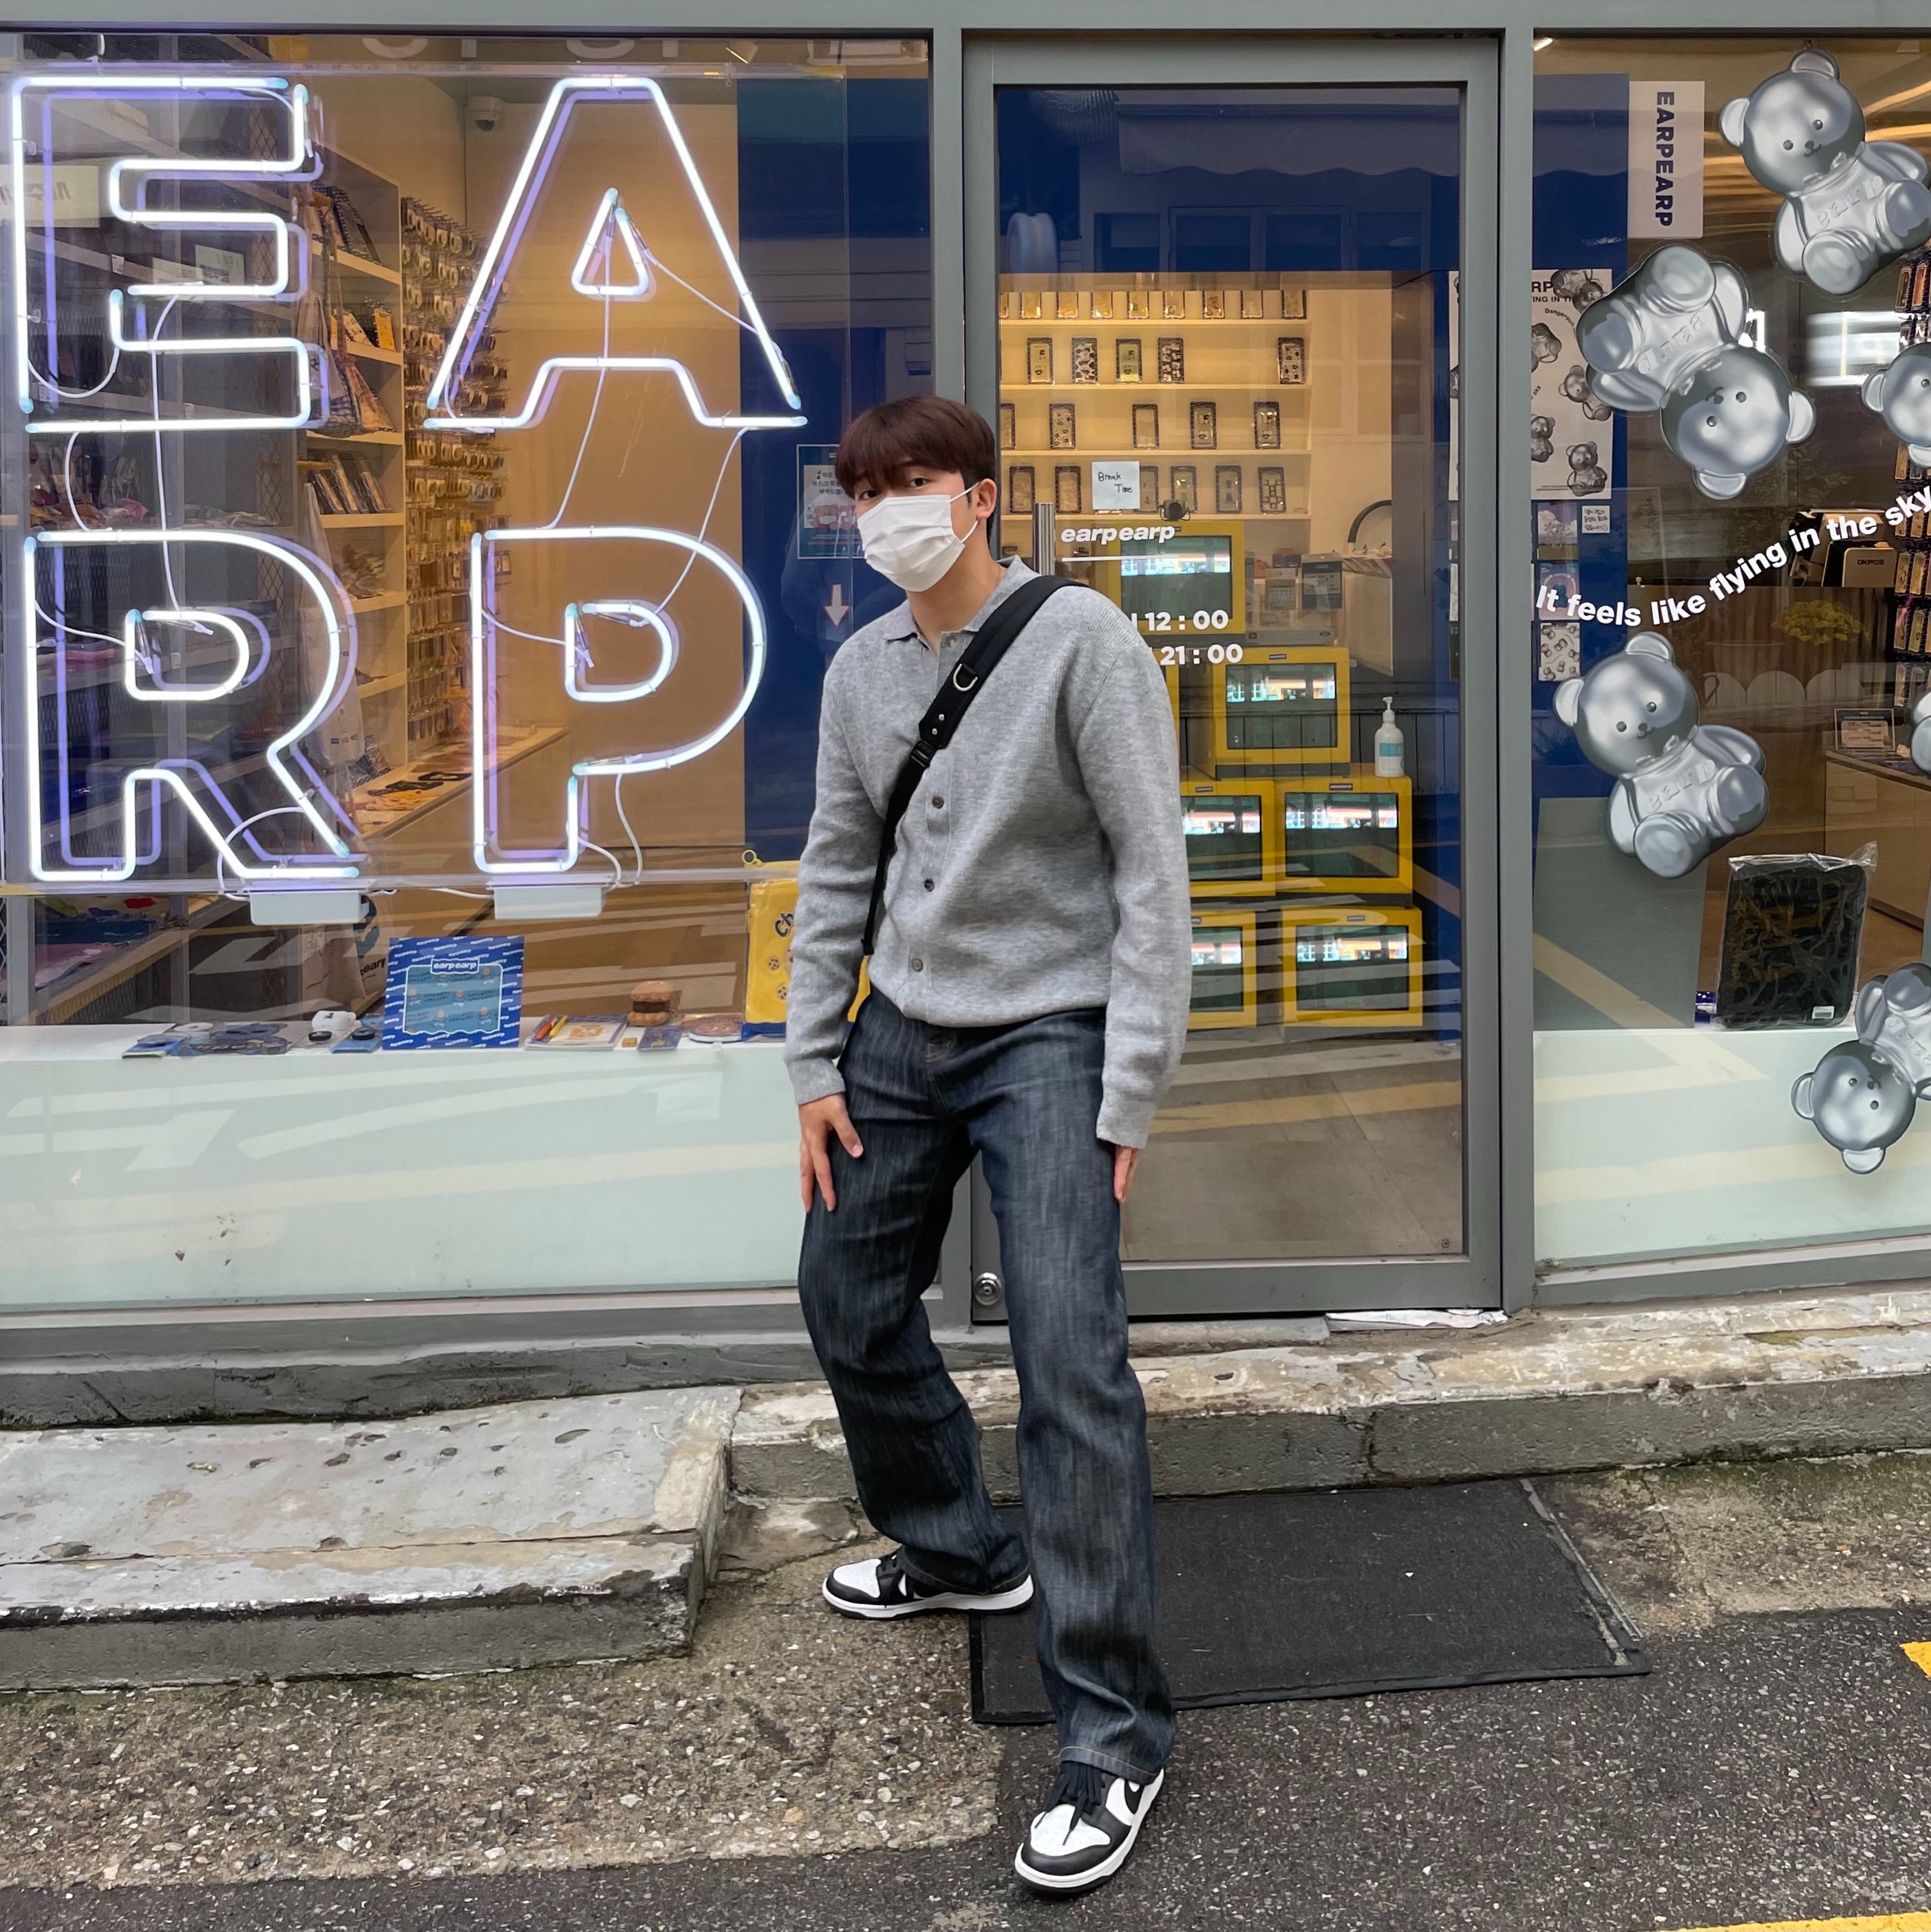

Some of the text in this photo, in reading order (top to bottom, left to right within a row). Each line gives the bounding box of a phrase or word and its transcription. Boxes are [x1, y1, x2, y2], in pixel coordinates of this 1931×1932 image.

[1655, 92, 1675, 226] EARPEARP
[1098, 471, 1122, 482] Break
[1113, 483, 1133, 493] Time
[1060, 525, 1175, 545] earpearp
[1535, 485, 1931, 627] It feels like flying in the sky
